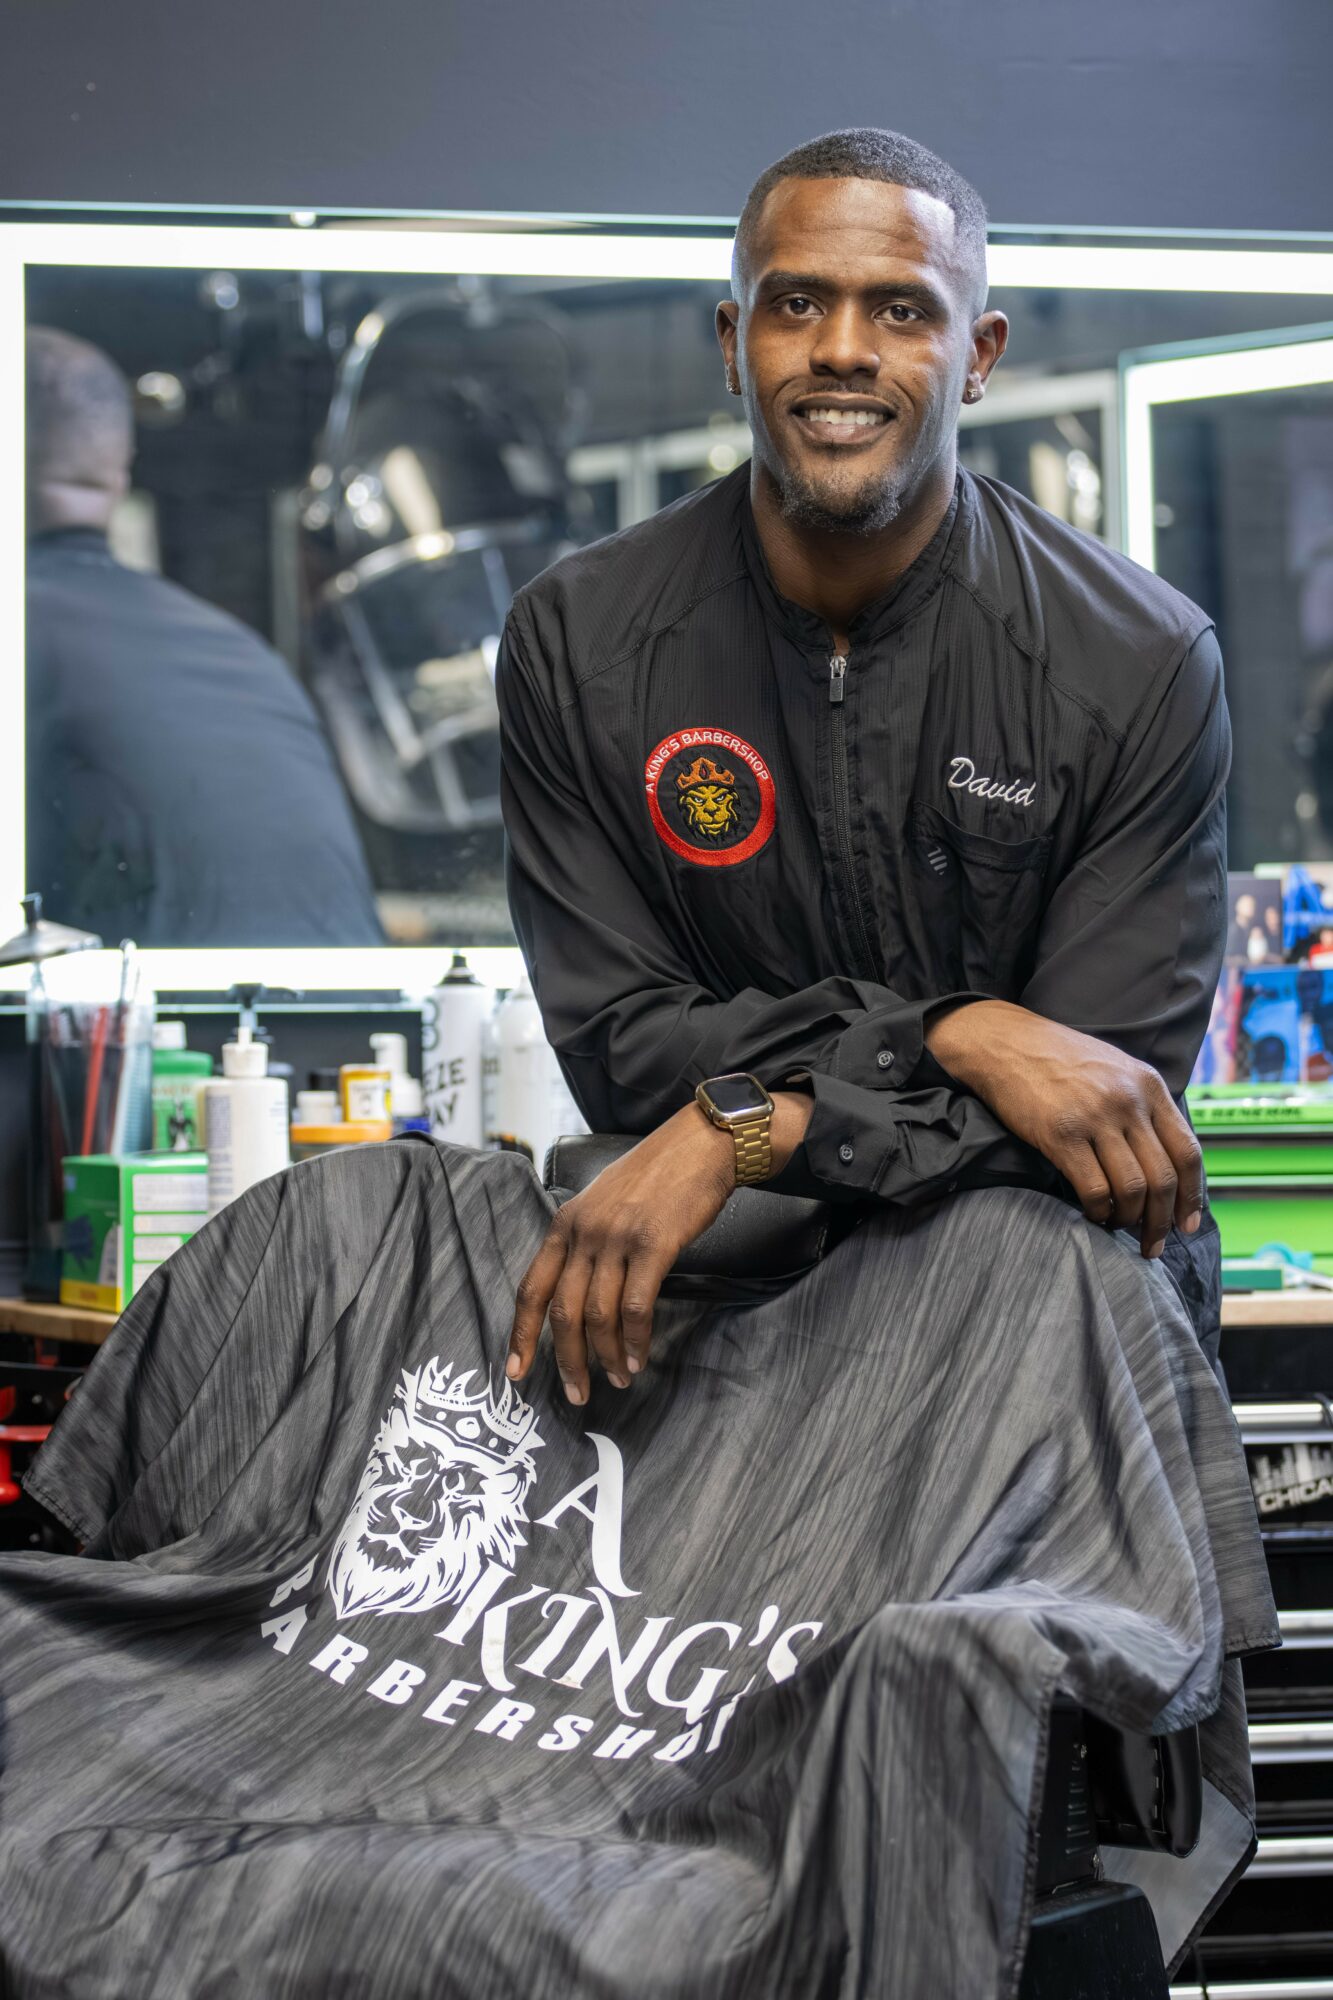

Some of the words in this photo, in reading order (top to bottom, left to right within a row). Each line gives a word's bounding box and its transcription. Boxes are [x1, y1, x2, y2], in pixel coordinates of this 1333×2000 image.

[646, 738, 681, 780] KING'S
[681, 731, 769, 780] BARBERSHOP
[645, 782, 655, 793] A
[947, 756, 1036, 807] David
[533, 1431, 642, 1597] A
[433, 1556, 823, 1725] KING'S
